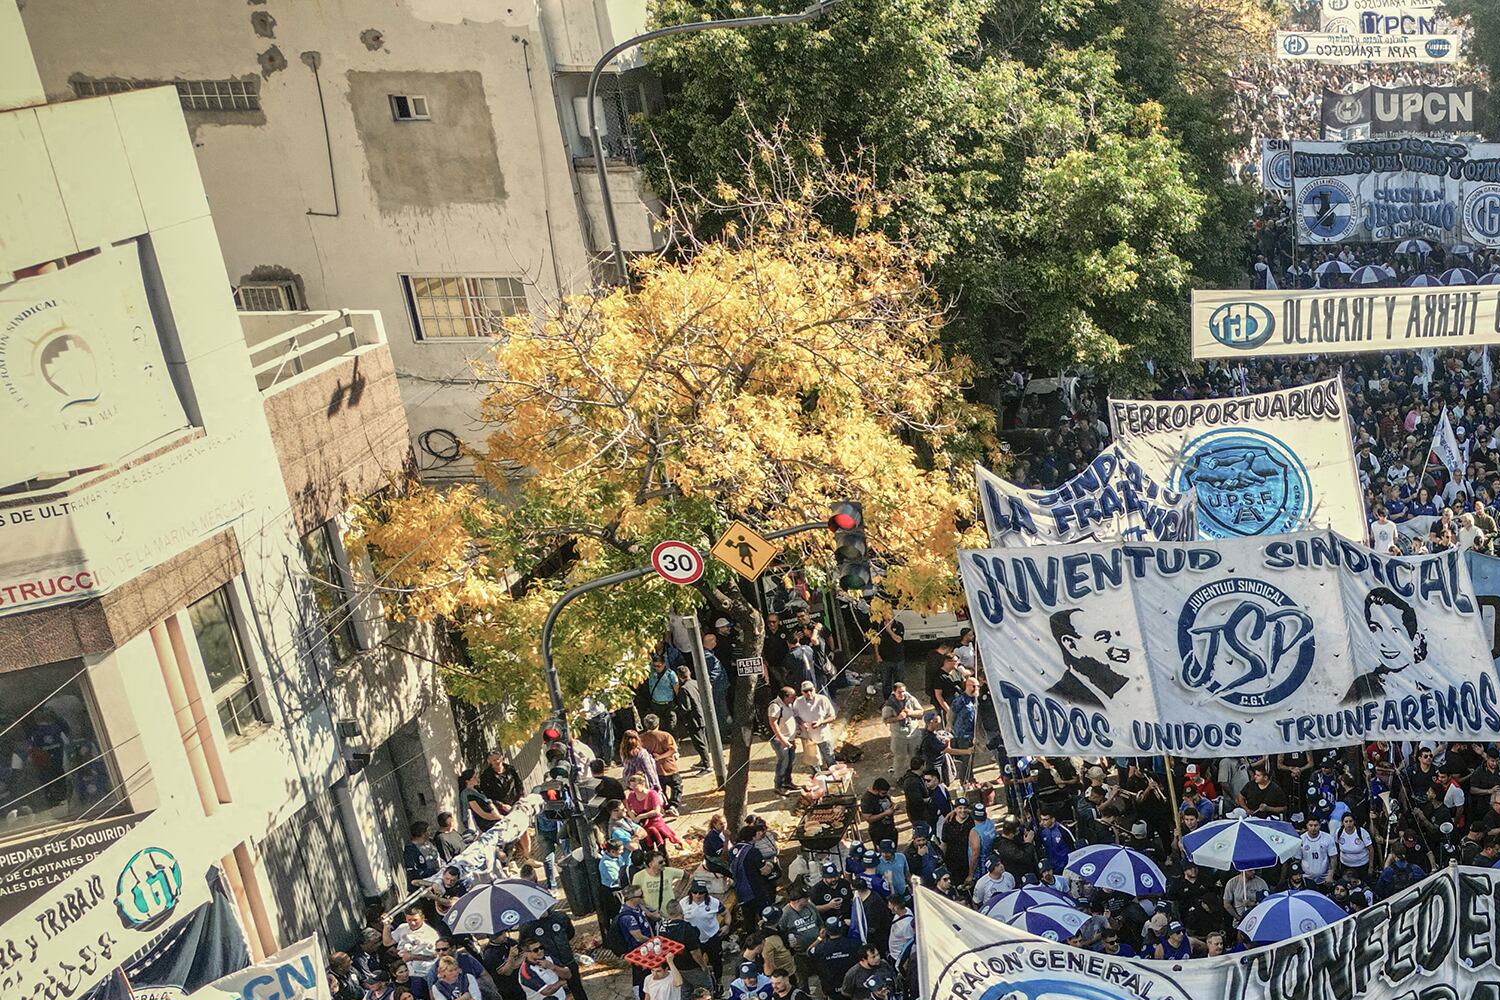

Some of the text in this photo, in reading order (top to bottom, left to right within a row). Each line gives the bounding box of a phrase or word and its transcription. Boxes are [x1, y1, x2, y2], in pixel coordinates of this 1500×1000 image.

[1375, 91, 1473, 126] UPCN
[1348, 138, 1468, 158] SINDICATO
[1295, 152, 1371, 177] EMPLEADOS
[1374, 153, 1401, 173] DEL
[1402, 153, 1448, 176] VIDRIO
[1449, 158, 1464, 179] Y
[1375, 188, 1445, 203] CRISTIAN
[1364, 202, 1457, 231] JERONIMO
[1111, 379, 1342, 436] FERROPORTUARIOS
[10, 508, 36, 525] DE
[662, 553, 694, 573] 30
[977, 540, 1476, 625] JUVENTUD SINDICAL
[1188, 578, 1285, 615] JUVENTUD SINDICAL
[1239, 692, 1271, 707] C.G.T.
[1001, 680, 1113, 750] TODOS
[1131, 718, 1242, 752] UNIDOS
[43, 823, 134, 857] FUE ADQUIRIDA
[5, 870, 23, 885] DE
[24, 855, 85, 880] CAPITANES
[1311, 852, 1320, 861] 10
[28, 873, 62, 893] DE LA
[35, 874, 107, 941] TRABAJO
